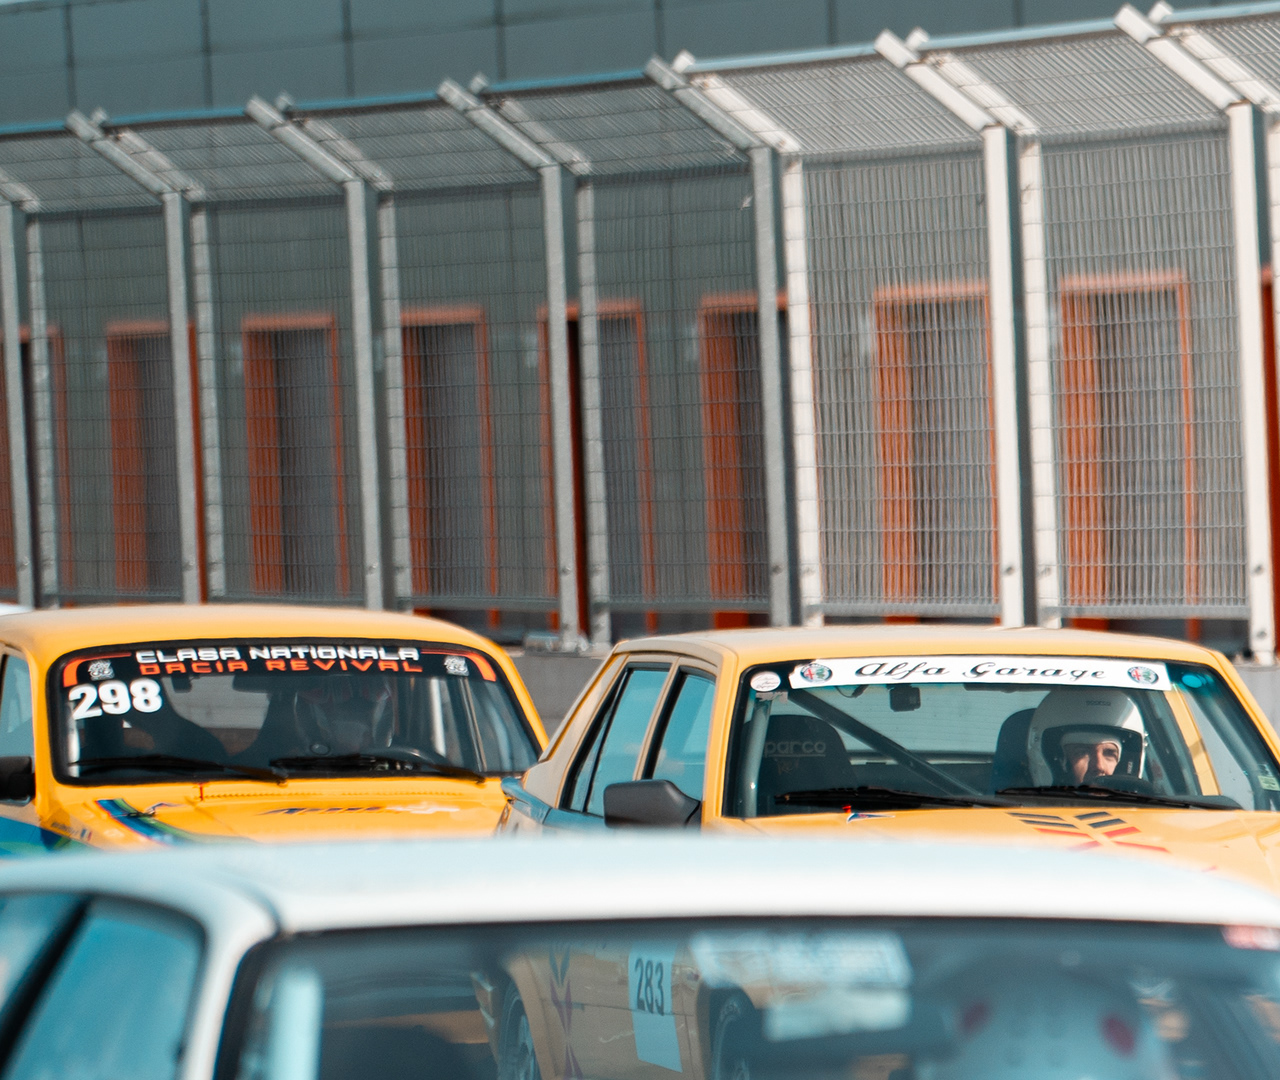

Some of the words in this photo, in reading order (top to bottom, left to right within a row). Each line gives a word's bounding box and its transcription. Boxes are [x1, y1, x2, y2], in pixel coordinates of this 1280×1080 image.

[135, 647, 241, 664] CLASA
[249, 645, 419, 661] NATIONALA
[140, 660, 248, 676] DACIA
[265, 659, 423, 673] REVIVAL
[855, 661, 950, 680] Alfa
[962, 662, 1107, 682] Garage
[69, 678, 163, 720] 298
[763, 739, 827, 758] parco
[635, 958, 664, 1016] 283
